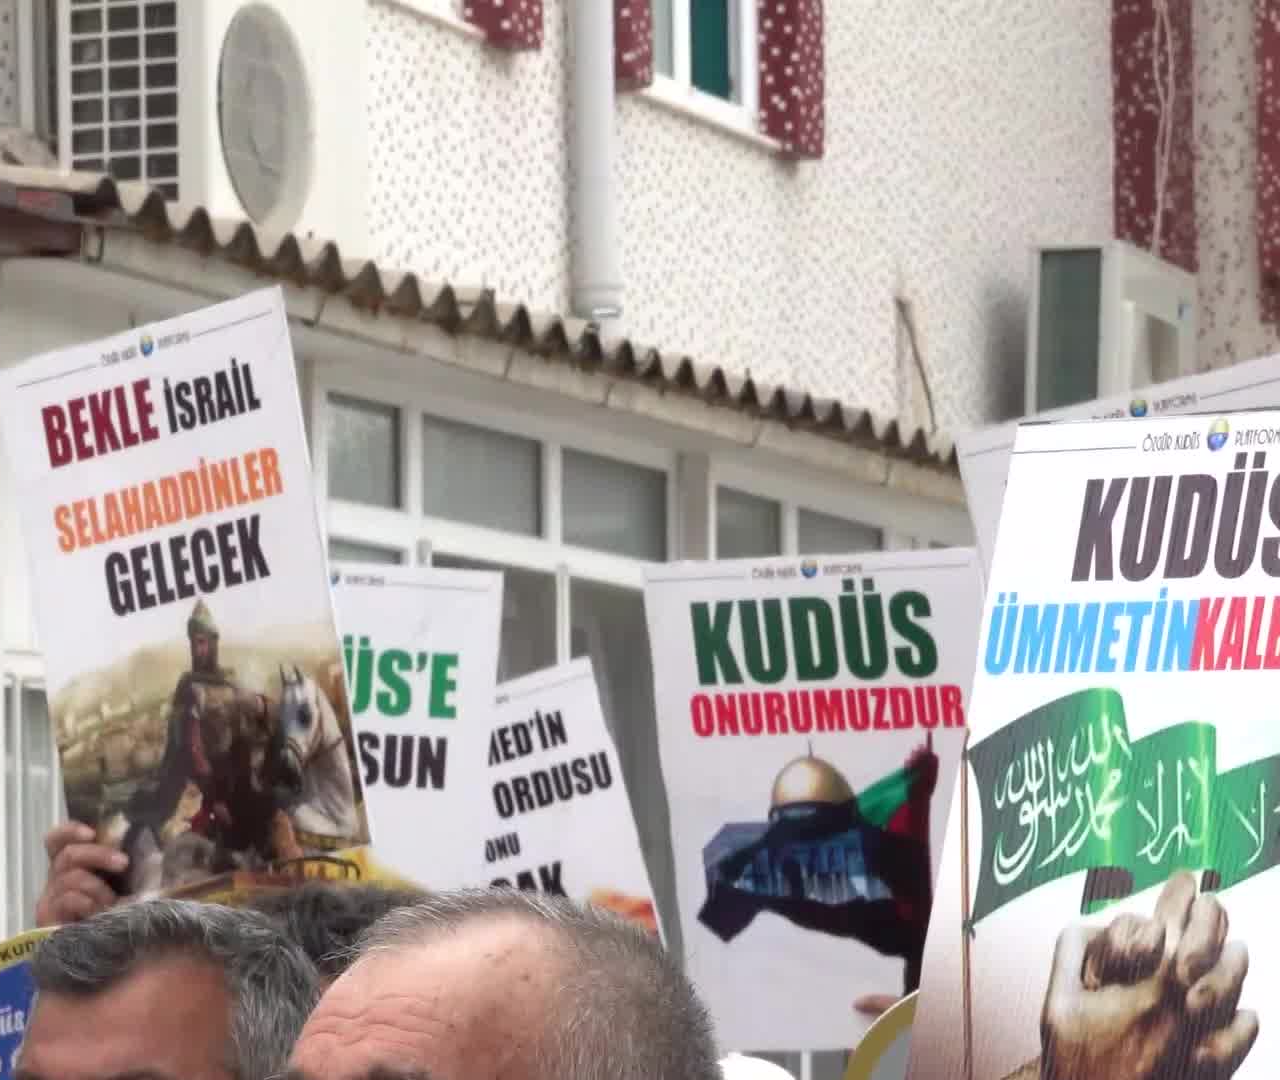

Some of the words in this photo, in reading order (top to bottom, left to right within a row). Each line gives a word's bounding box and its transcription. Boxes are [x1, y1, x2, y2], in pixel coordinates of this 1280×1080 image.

[41, 378, 160, 468] BEKLE
[163, 357, 262, 434] İSRAİL
[53, 447, 284, 555] SELAHADDİNLER
[104, 514, 271, 617] GELECEK
[689, 577, 938, 686] KUDÜS
[690, 684, 966, 738] ONURUMUZDUR
[492, 751, 612, 819] ORDUSU
